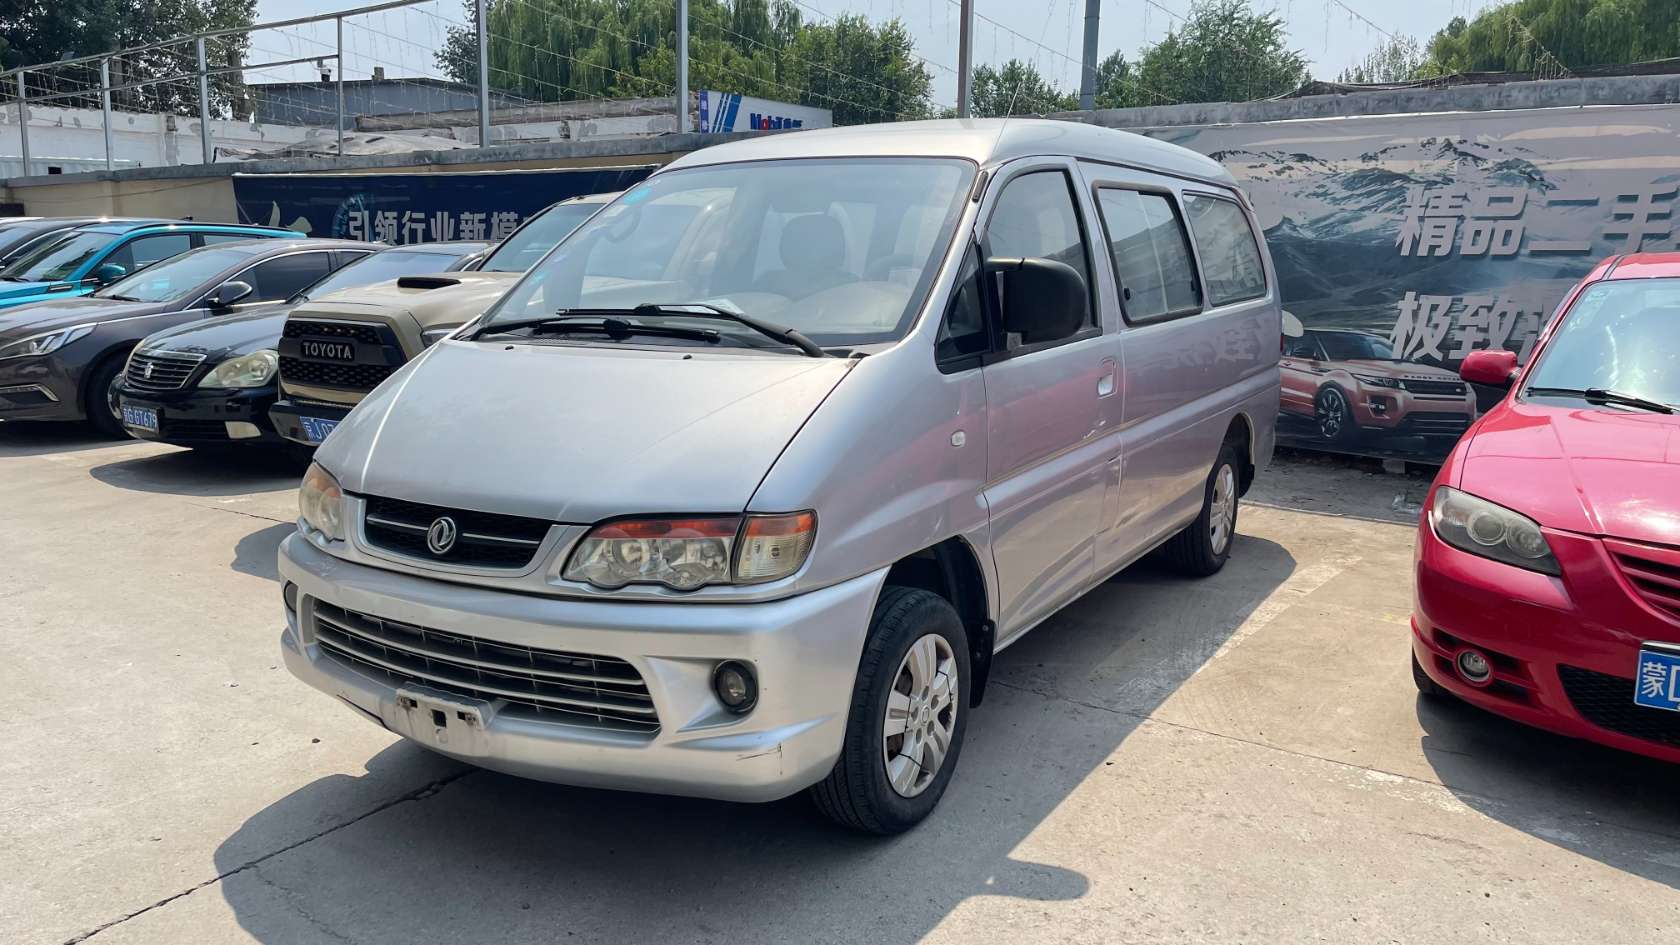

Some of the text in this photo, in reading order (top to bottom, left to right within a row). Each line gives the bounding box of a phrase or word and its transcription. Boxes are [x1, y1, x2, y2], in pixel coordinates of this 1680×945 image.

[349, 210, 530, 245] 引领行业新模
[1395, 180, 1680, 257] 精品二手
[303, 342, 352, 359] TOYOTA
